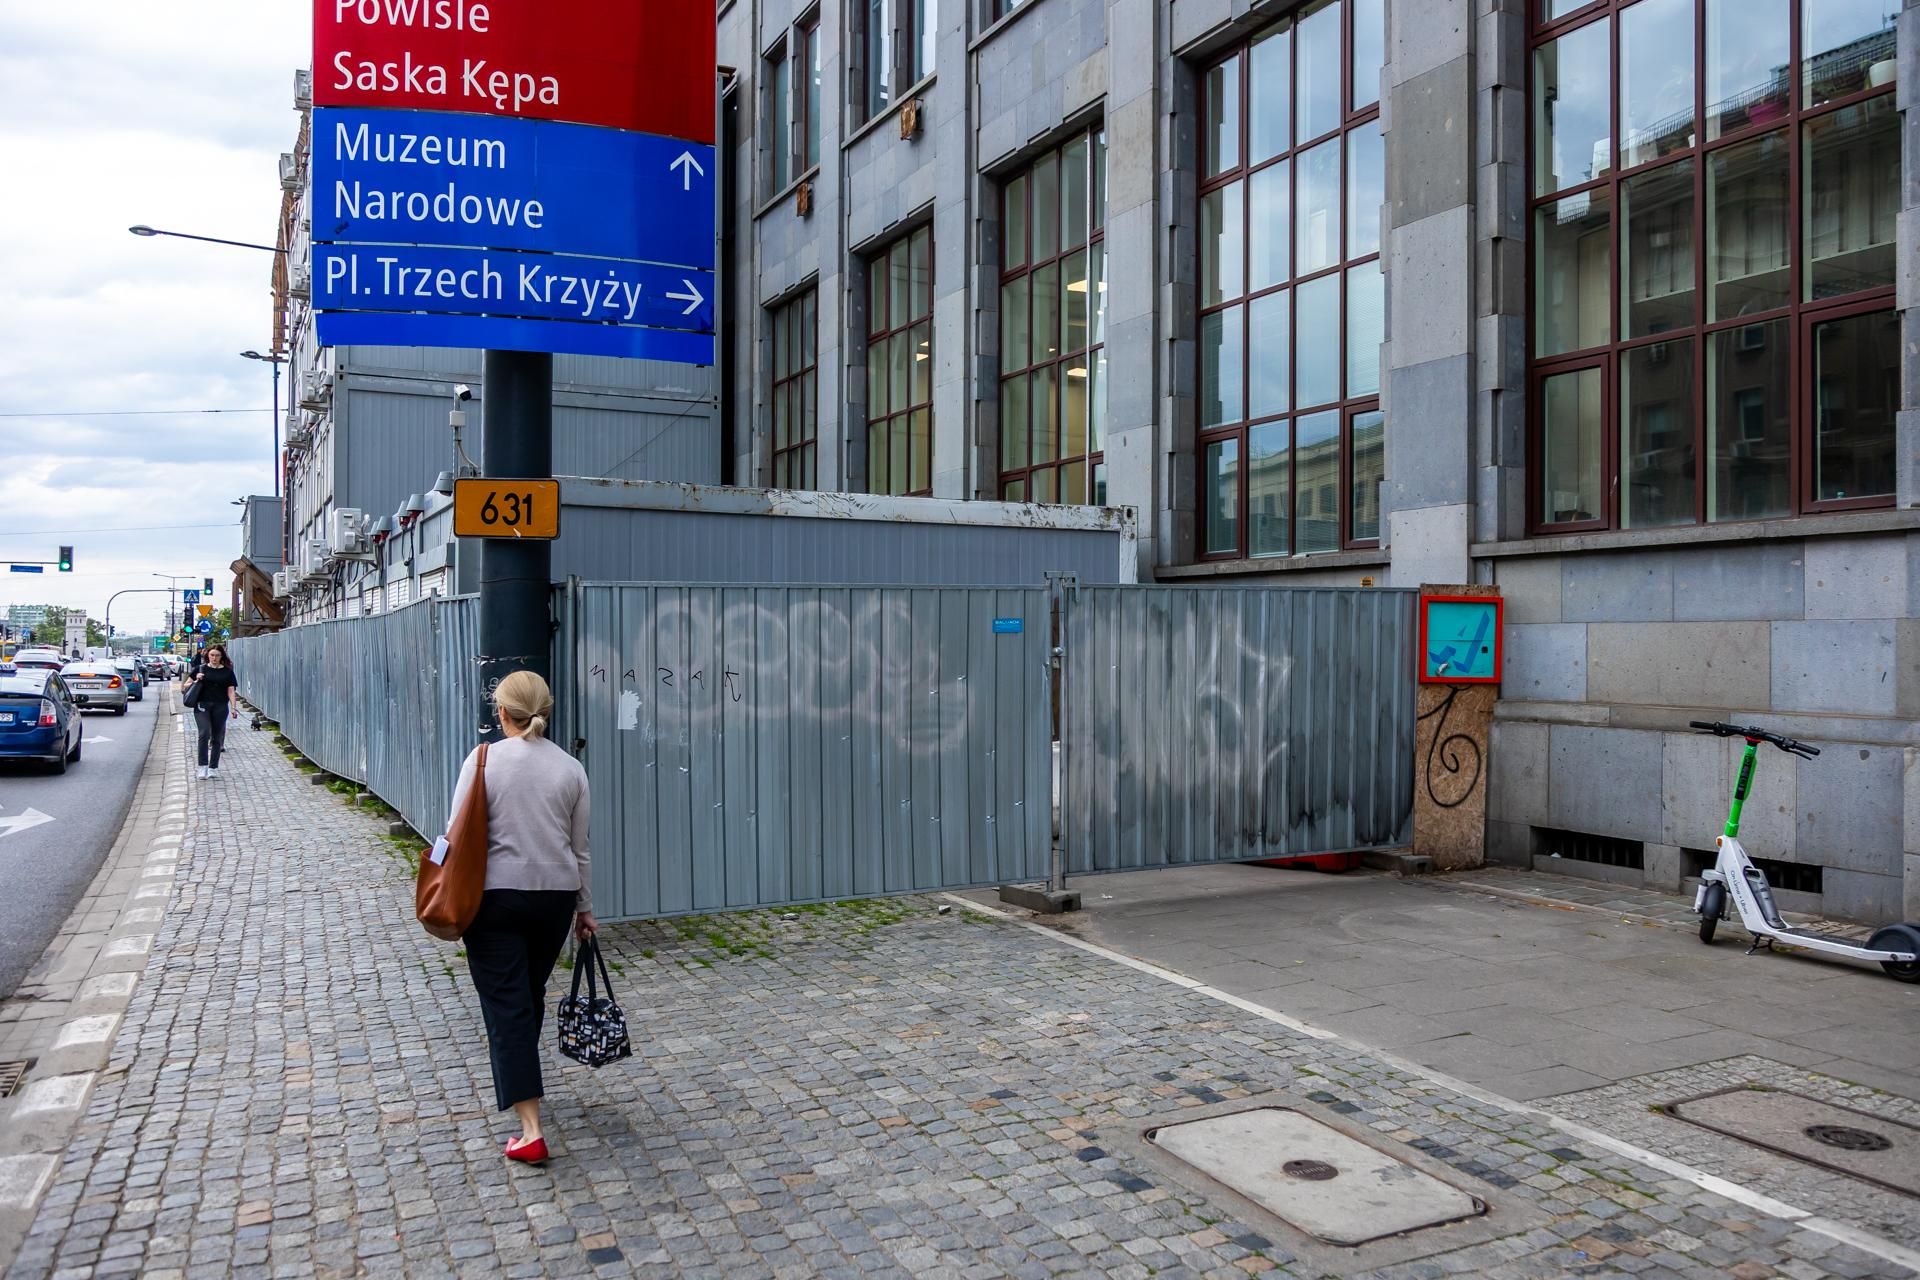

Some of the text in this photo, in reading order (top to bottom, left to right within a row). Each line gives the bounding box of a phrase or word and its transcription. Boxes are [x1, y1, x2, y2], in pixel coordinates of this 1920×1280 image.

[333, 51, 559, 112] Saska Kępa
[335, 122, 506, 169] Muzeum
[335, 181, 544, 229] Narodowe
[519, 264, 642, 320] Krzyży
[480, 491, 533, 526] 631
